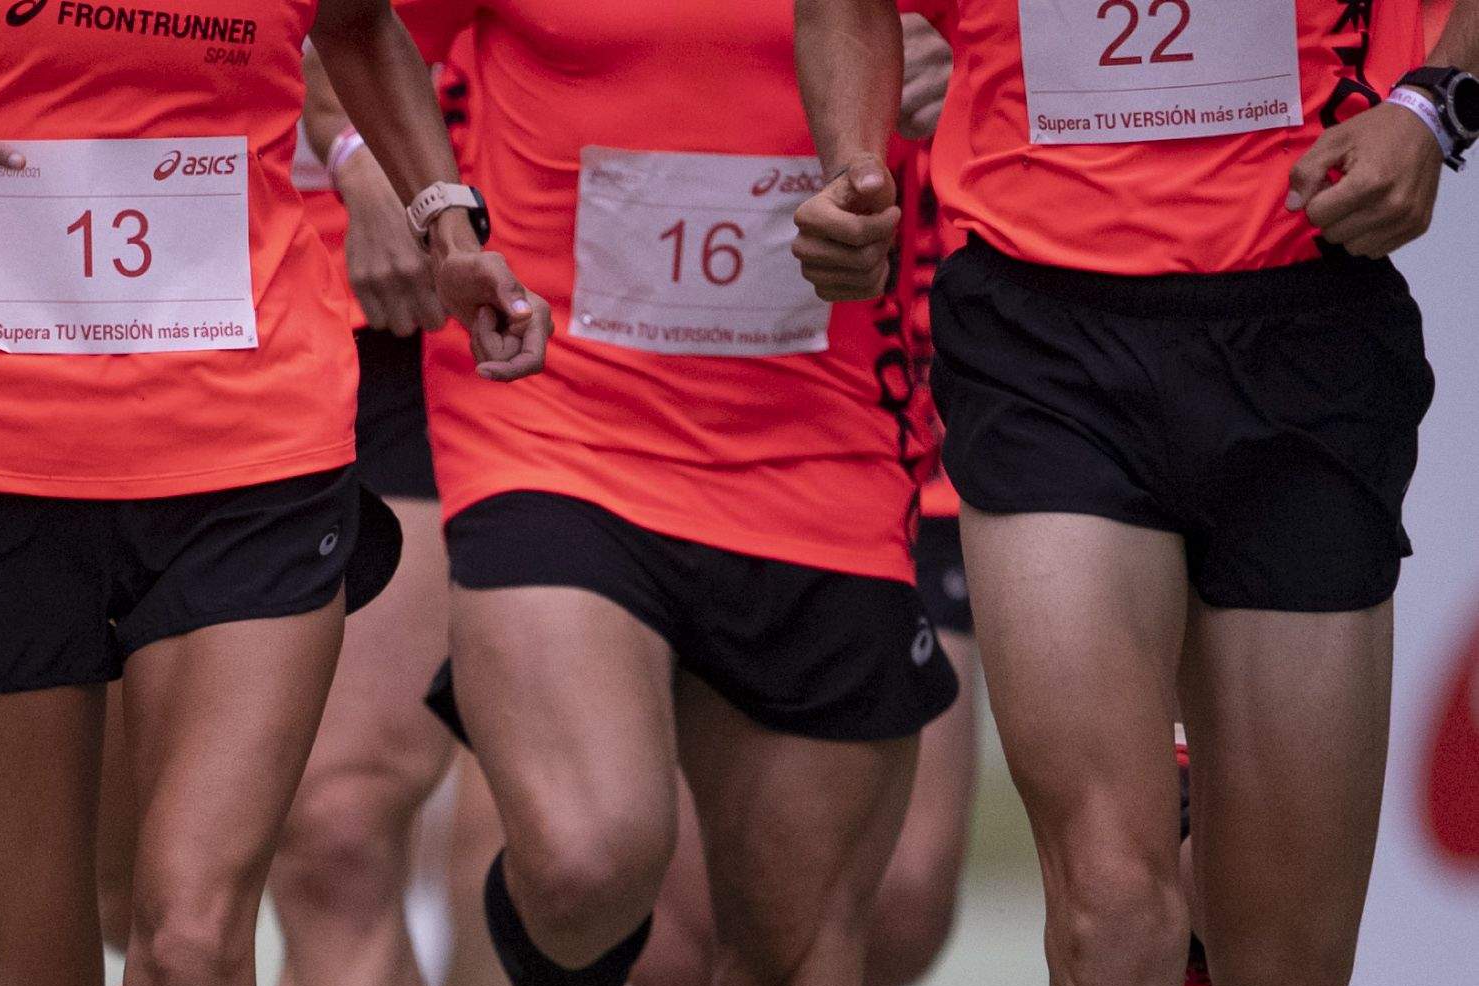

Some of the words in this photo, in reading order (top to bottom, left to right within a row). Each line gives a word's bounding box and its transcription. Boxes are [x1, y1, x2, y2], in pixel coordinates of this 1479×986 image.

[57, 1, 257, 45] FRONTRUNNER
[1096, 0, 1194, 67] 22
[204, 46, 252, 66] SPAIN
[1038, 114, 1091, 135] Supera
[1094, 113, 1116, 130] TU
[1120, 104, 1196, 129] VERSIÓN
[1200, 105, 1234, 124] más
[1238, 100, 1288, 121] rápida
[182, 154, 237, 176] asics
[779, 171, 825, 193] asic
[67, 209, 152, 278] 13
[659, 218, 745, 286] 16
[55, 324, 77, 340] TU
[80, 319, 153, 341] VERSIÓN
[158, 322, 190, 339] más
[193, 321, 244, 342] rápida
[637, 322, 659, 341] TU
